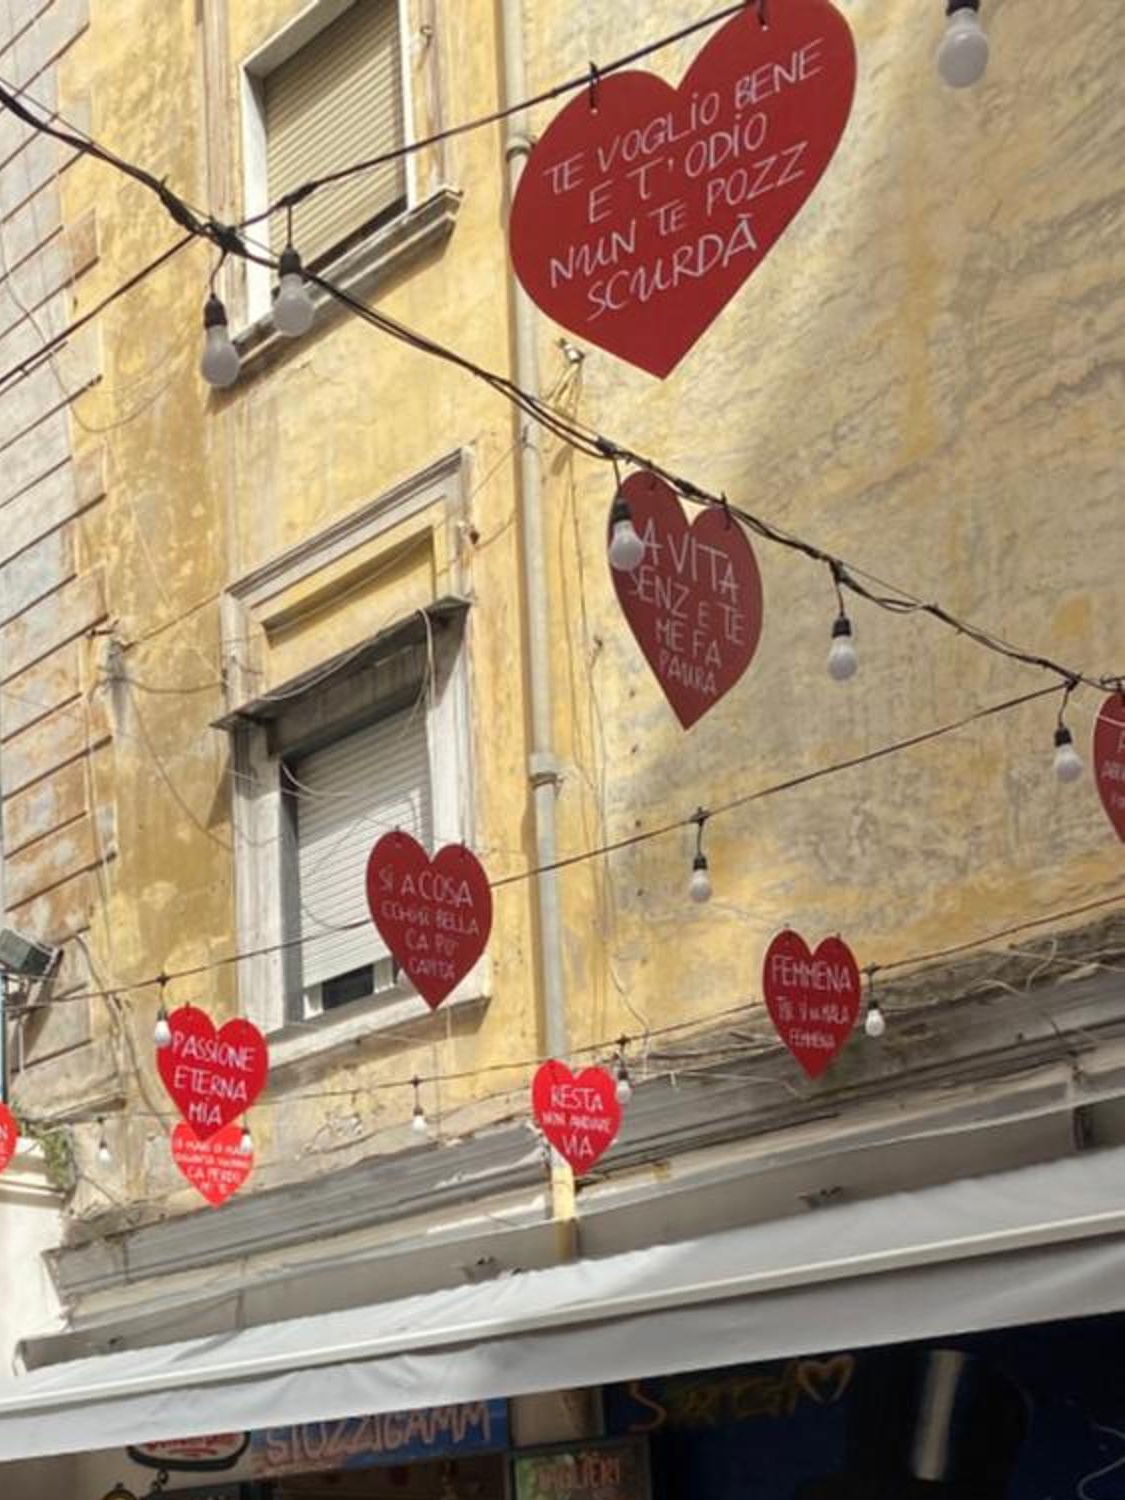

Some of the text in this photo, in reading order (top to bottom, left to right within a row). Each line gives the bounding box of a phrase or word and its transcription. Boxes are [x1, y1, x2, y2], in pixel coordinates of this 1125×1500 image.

[543, 37, 825, 195] TE VOGLIO BENE
[549, 141, 809, 289] NUN TE POZZ
[588, 180, 613, 224] E
[667, 530, 739, 602] VITA
[716, 601, 747, 646] TE
[172, 1030, 254, 1073] PASSIONE
[174, 1064, 248, 1101] ETERNA
[551, 1084, 603, 1113] RESTA
[188, 1097, 223, 1125] MIA
